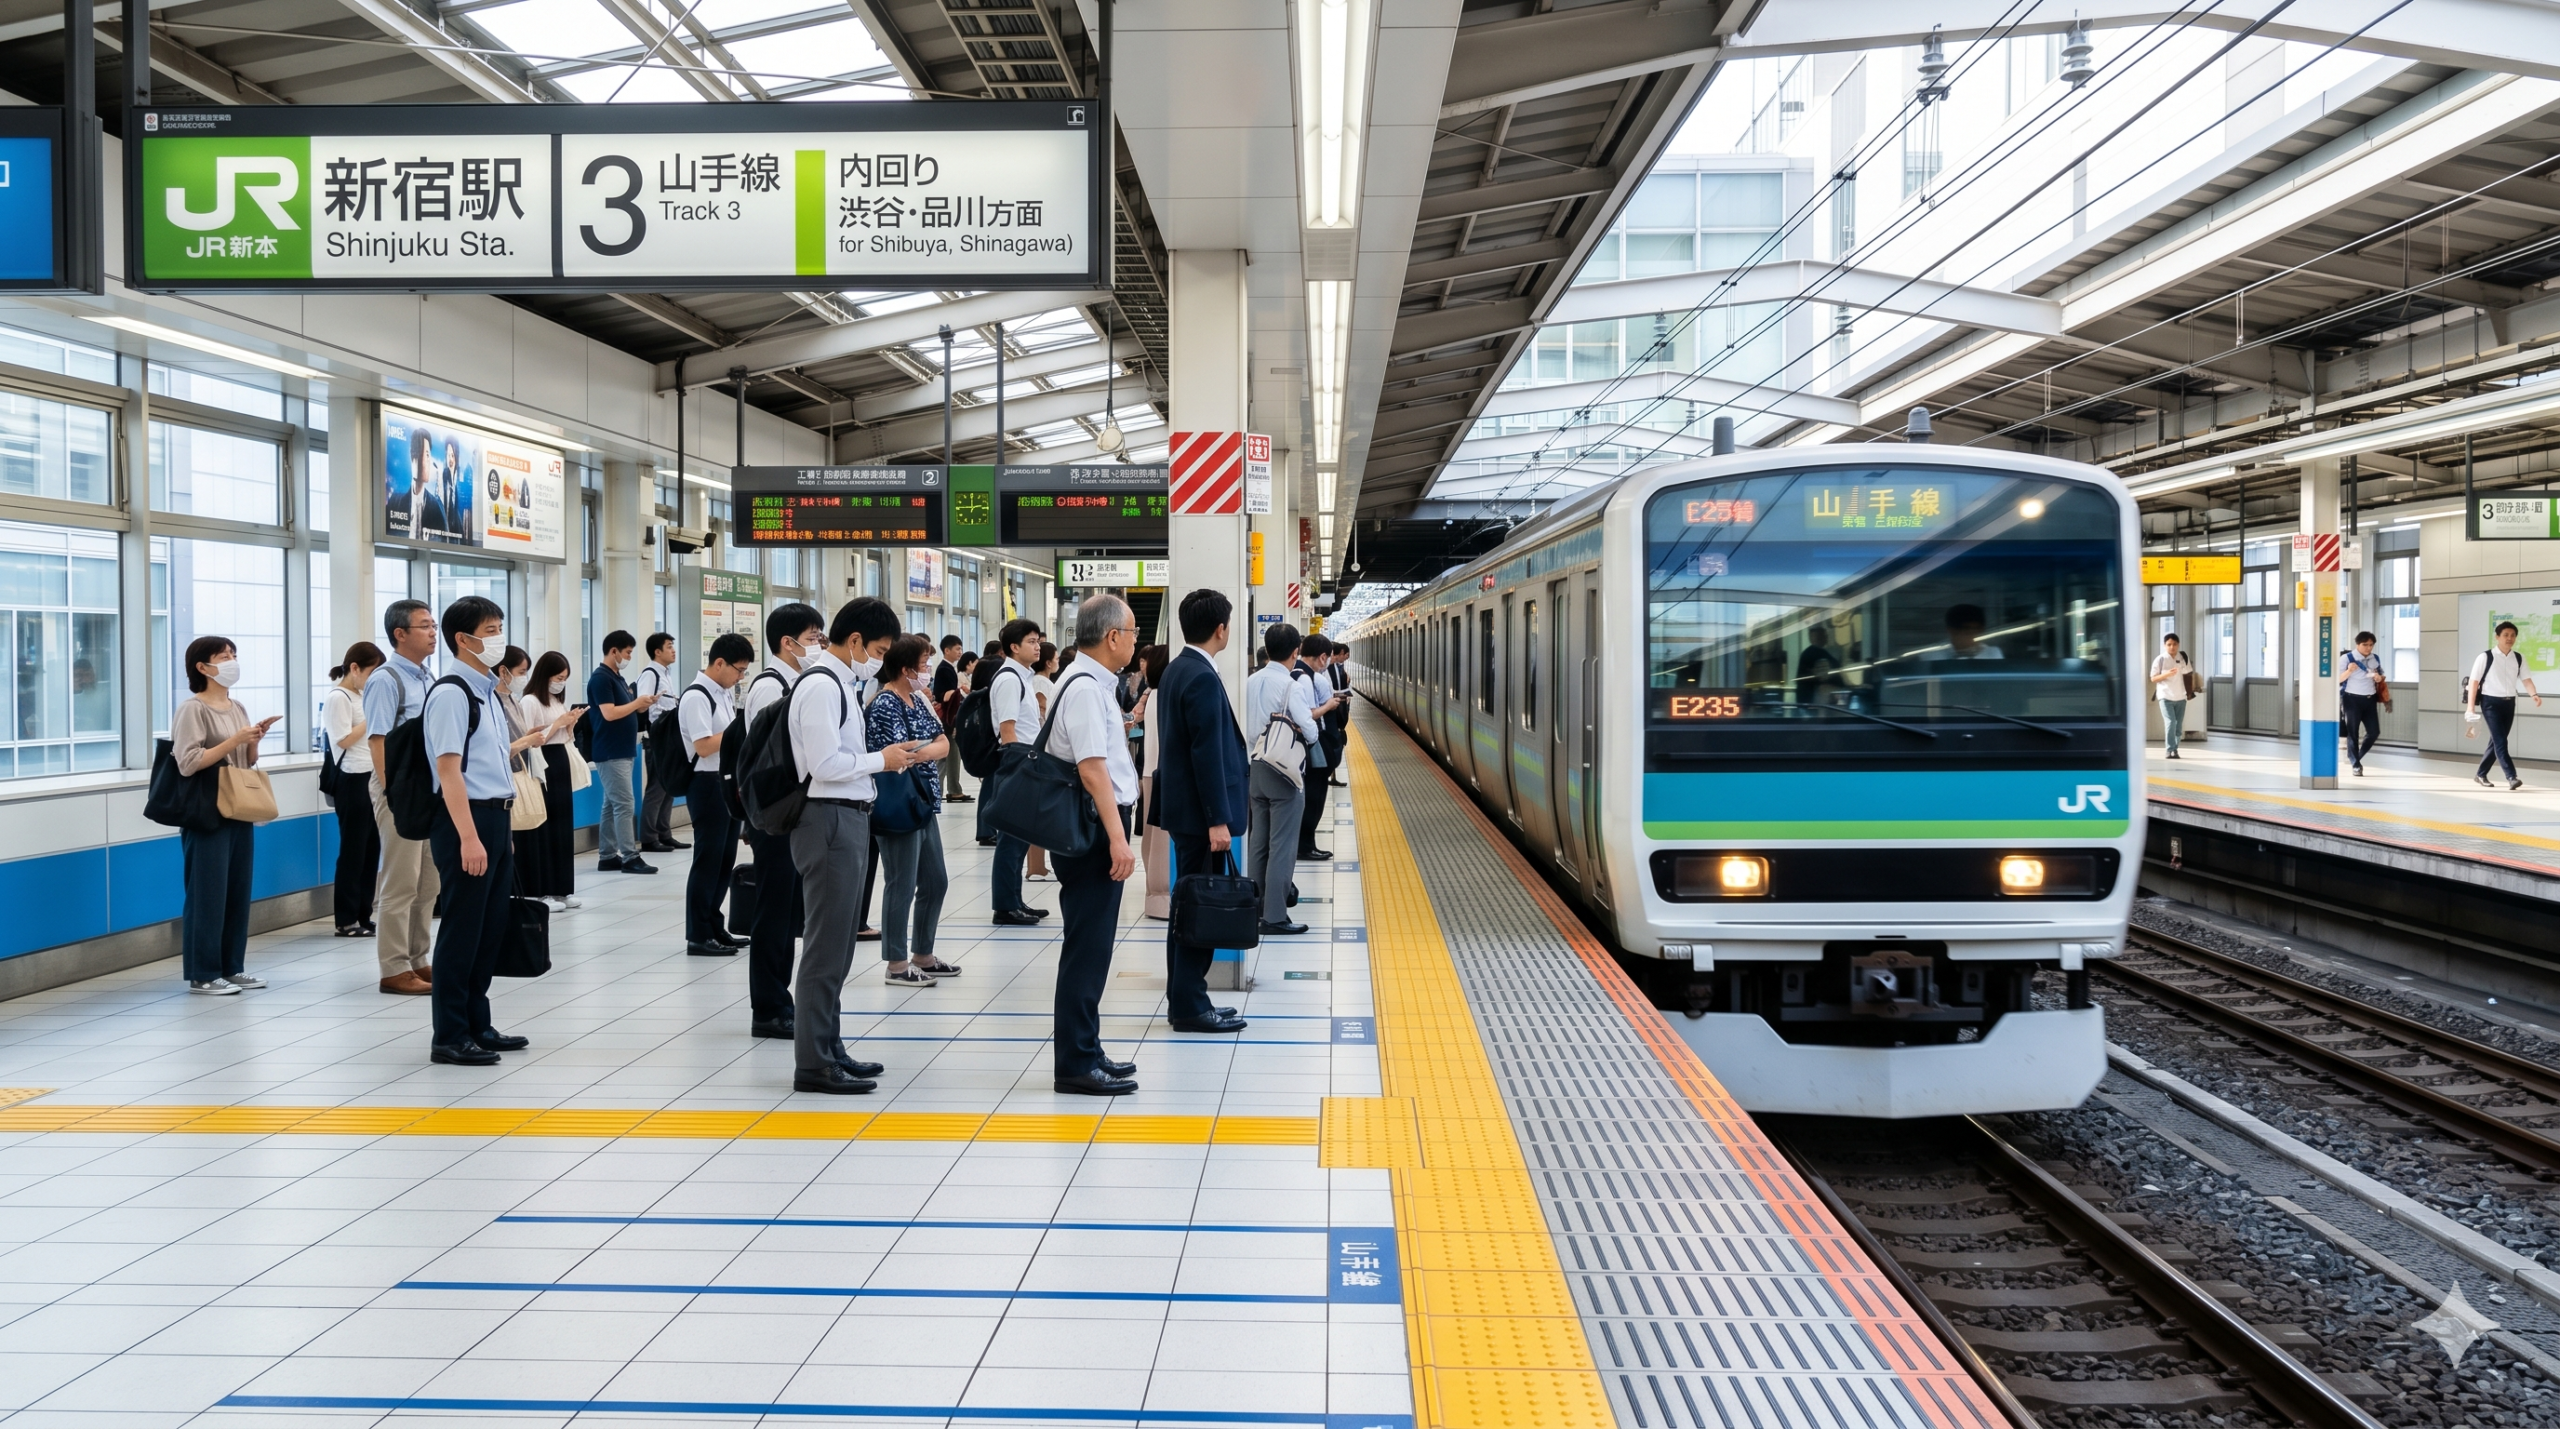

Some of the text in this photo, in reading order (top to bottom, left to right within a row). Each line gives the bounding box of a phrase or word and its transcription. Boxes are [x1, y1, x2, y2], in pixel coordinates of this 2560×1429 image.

[659, 152, 781, 193] 山手線
[840, 152, 939, 188] 内回り
[165, 155, 301, 231] JR
[324, 156, 525, 222] 新宿駅
[579, 154, 647, 257] 3
[658, 200, 741, 221] Track 3
[838, 195, 1044, 229] 渋谷・品川方面
[326, 230, 514, 264] Shinjuku Sta.
[838, 233, 1073, 257] for Shibuya, Shinagawa)
[925, 471, 937, 485] 2
[1812, 487, 1941, 518] 山手線
[2482, 503, 2494, 520] 3
[1671, 696, 1741, 718] E235
[2057, 784, 2112, 814] JR
